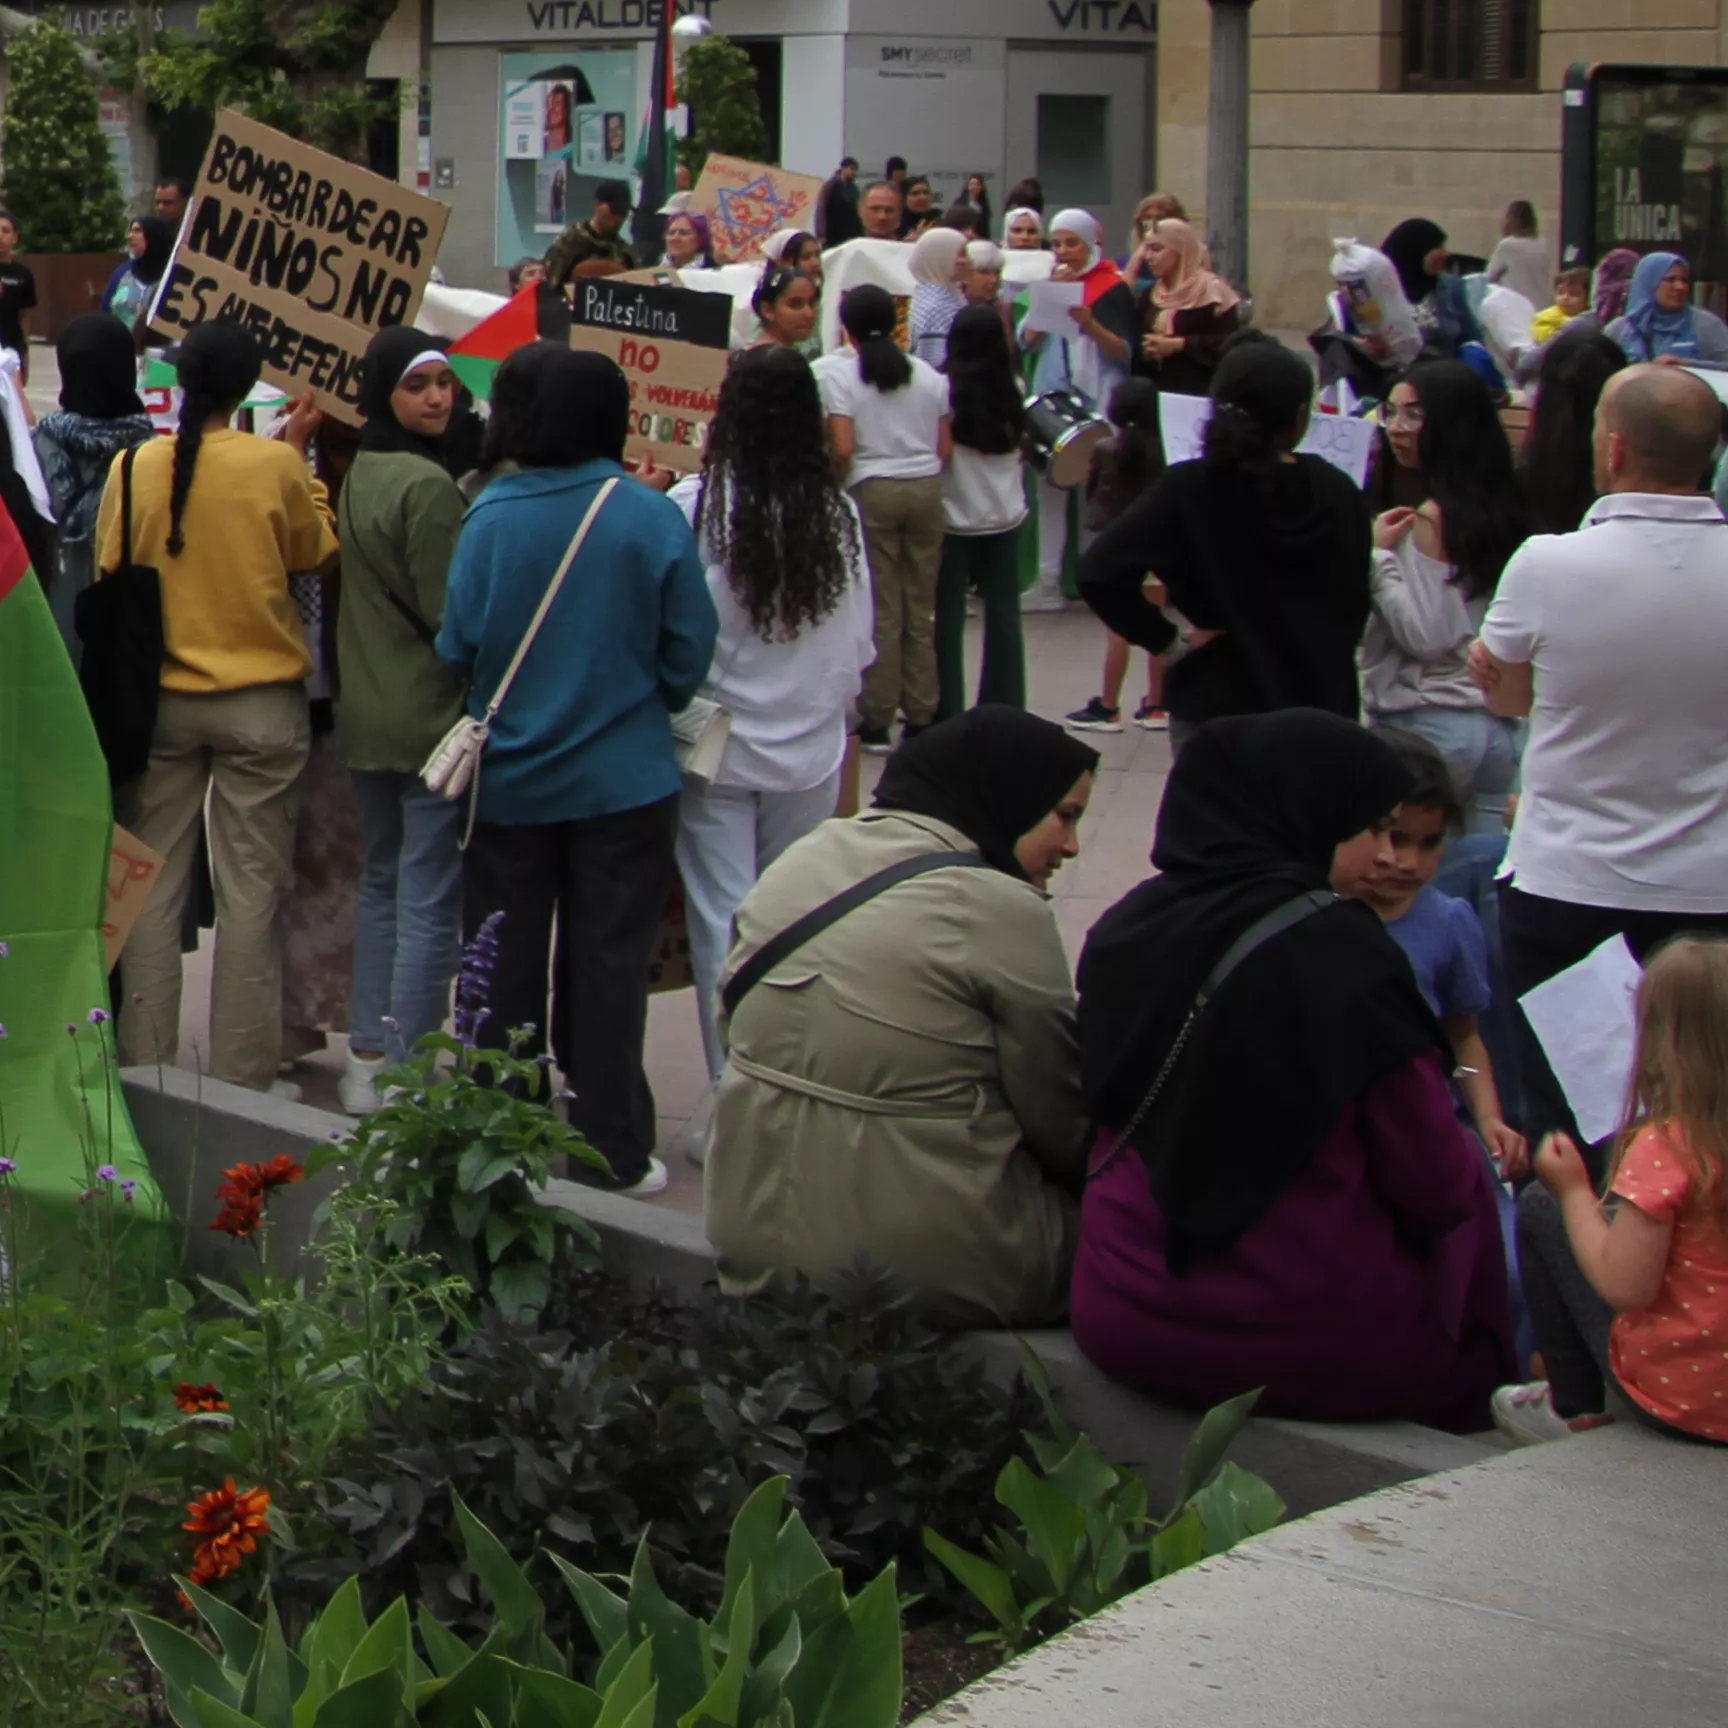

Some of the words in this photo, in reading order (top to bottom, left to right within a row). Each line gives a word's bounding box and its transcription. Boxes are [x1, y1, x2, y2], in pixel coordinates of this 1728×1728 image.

[114, 7, 163, 35] GAS
[206, 134, 428, 269] BOMBARDEAR
[187, 194, 344, 313] NIÑOS
[343, 259, 413, 330] NO
[155, 263, 219, 330] ES
[584, 284, 680, 333] Palestina
[627, 409, 708, 450] COLORES
